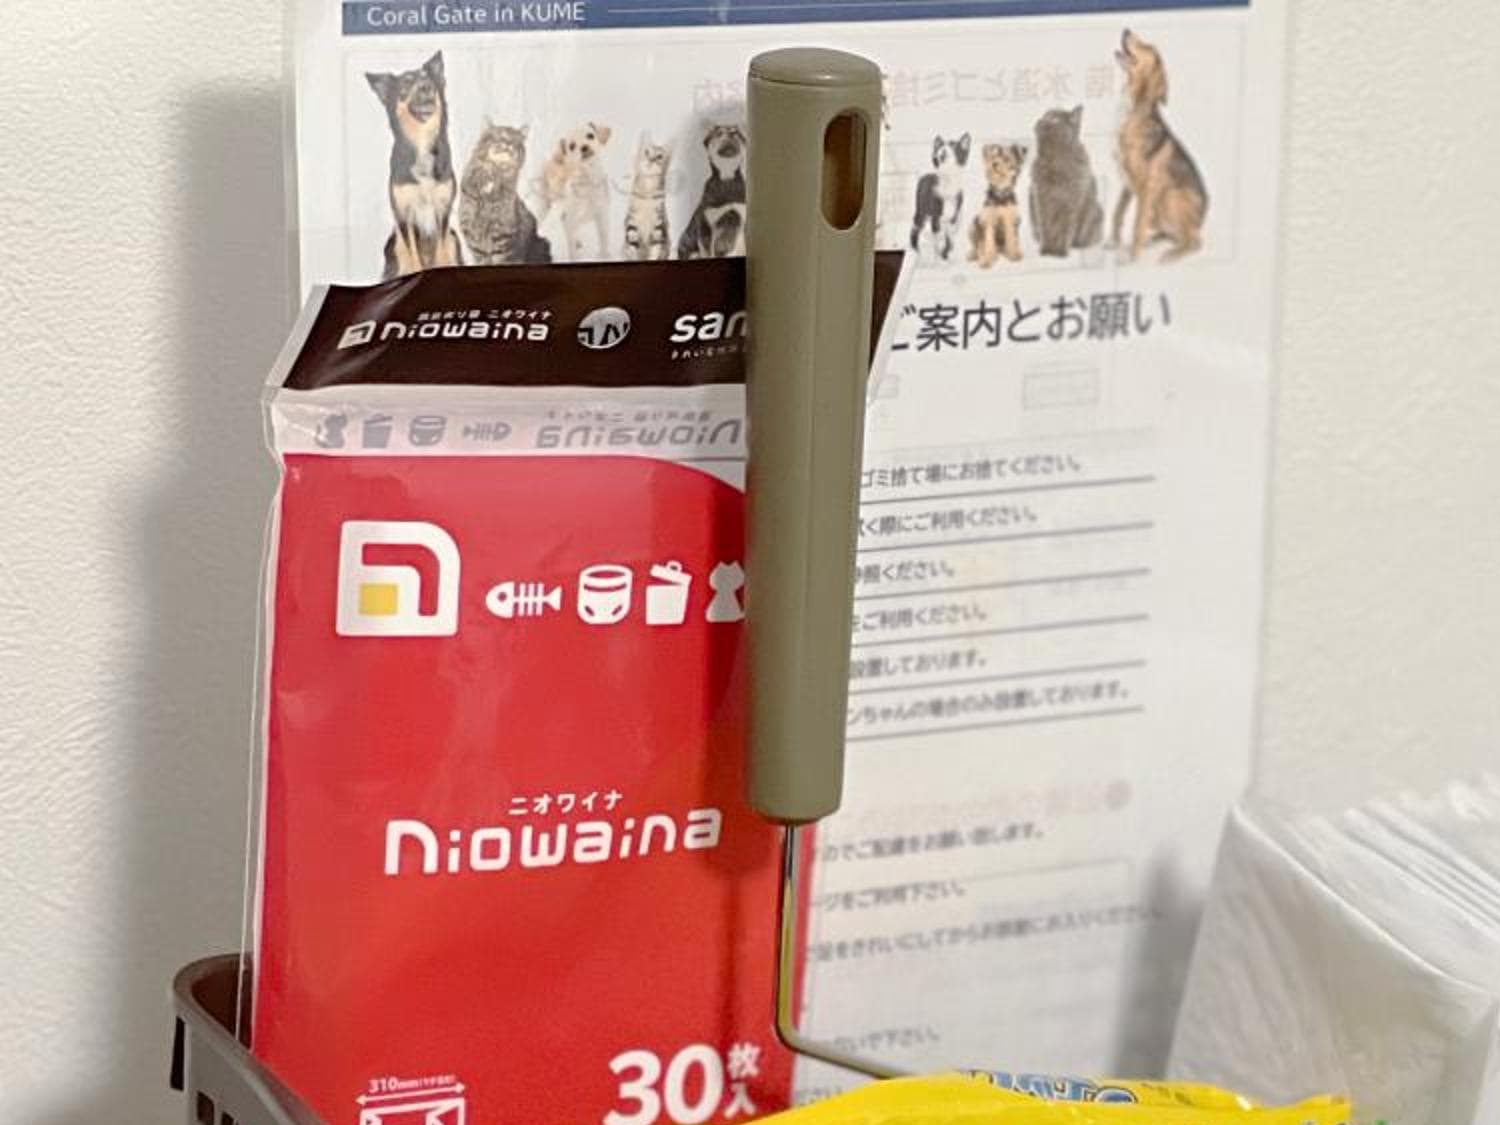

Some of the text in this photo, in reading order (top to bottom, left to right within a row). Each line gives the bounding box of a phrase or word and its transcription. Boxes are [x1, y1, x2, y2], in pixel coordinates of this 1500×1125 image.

[366, 1, 586, 26] Coral Gate in KUME
[380, 320, 550, 342] niowaina
[508, 788, 623, 816] ニオワイナ
[383, 807, 723, 876] niowaina
